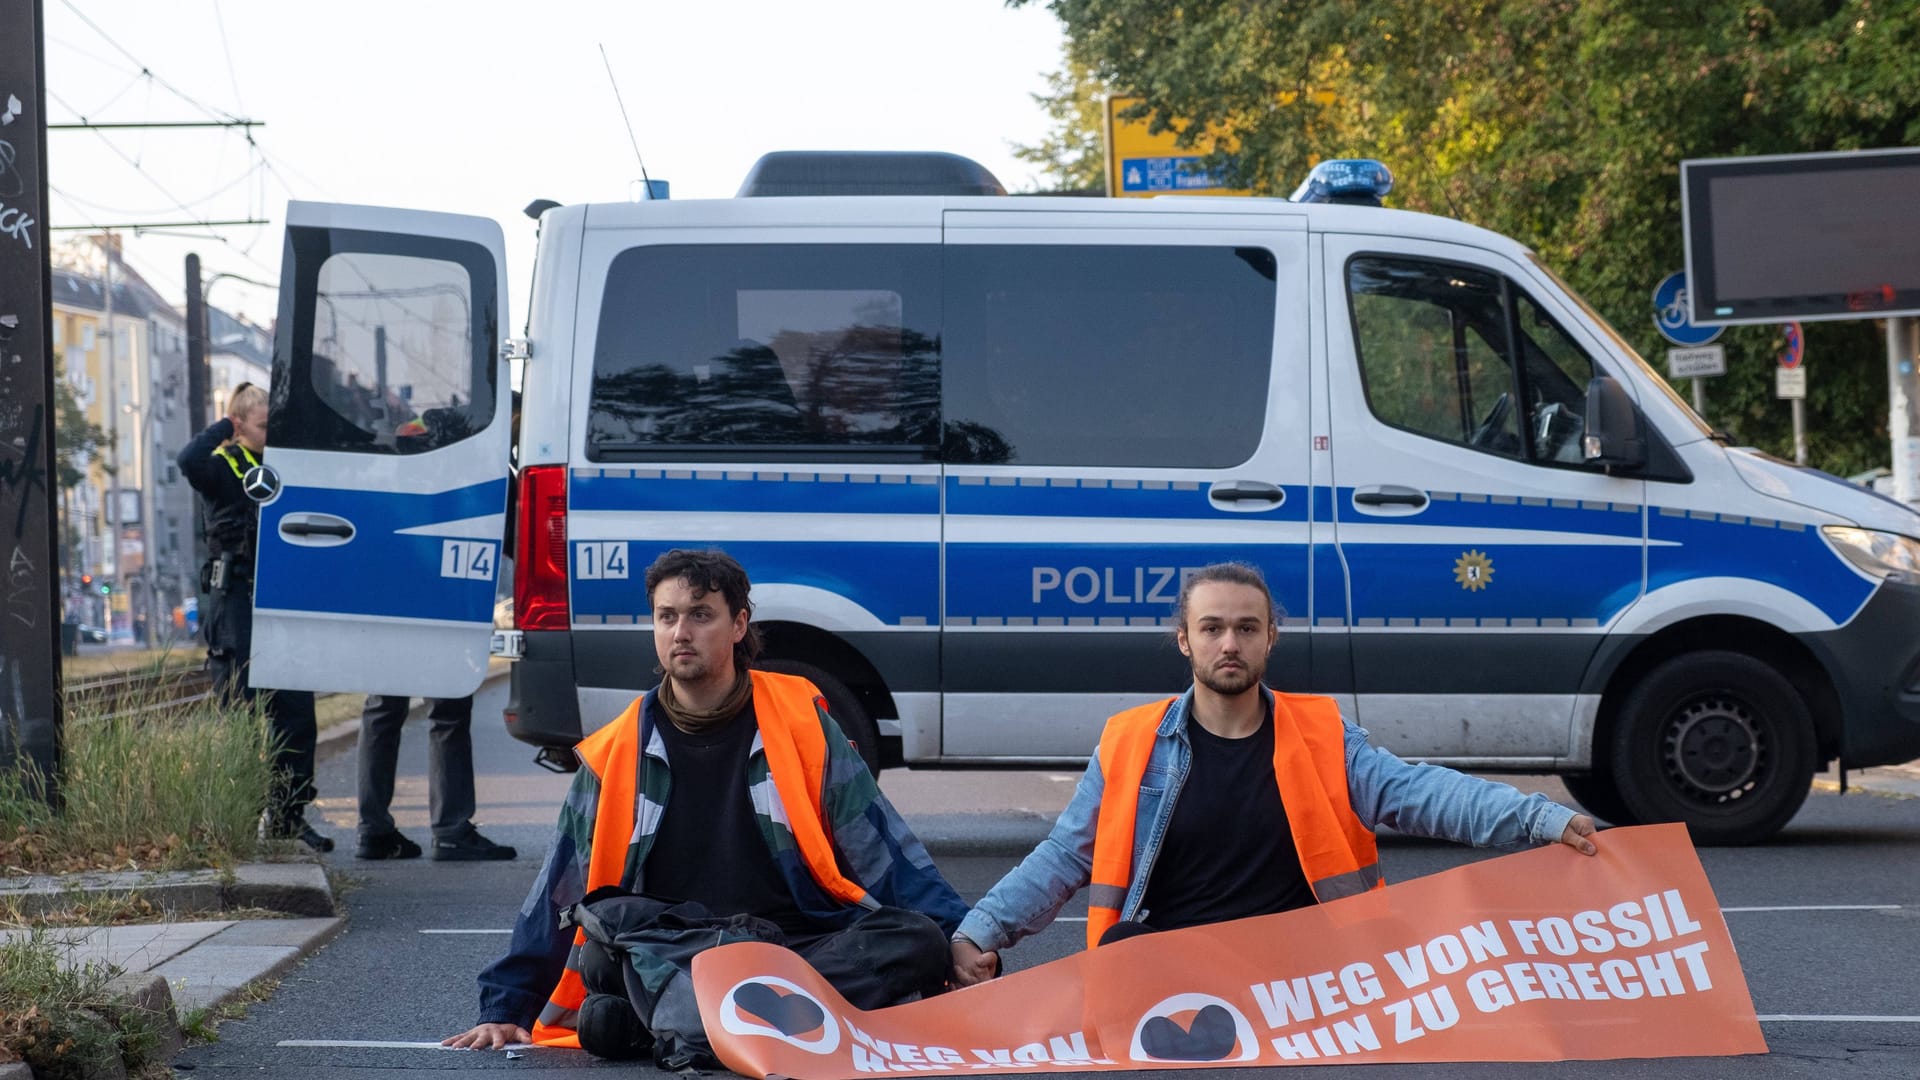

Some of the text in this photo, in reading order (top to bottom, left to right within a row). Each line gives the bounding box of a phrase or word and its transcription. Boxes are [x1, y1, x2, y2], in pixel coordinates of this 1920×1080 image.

[450, 544, 490, 576] 14
[584, 545, 625, 576] 14
[1031, 565, 1205, 604] POLIZ
[1250, 889, 1701, 1029] WEG VON FOSSIL
[1271, 941, 1713, 1060] HIN ZU GERECHT
[842, 1016, 966, 1064] WEG
